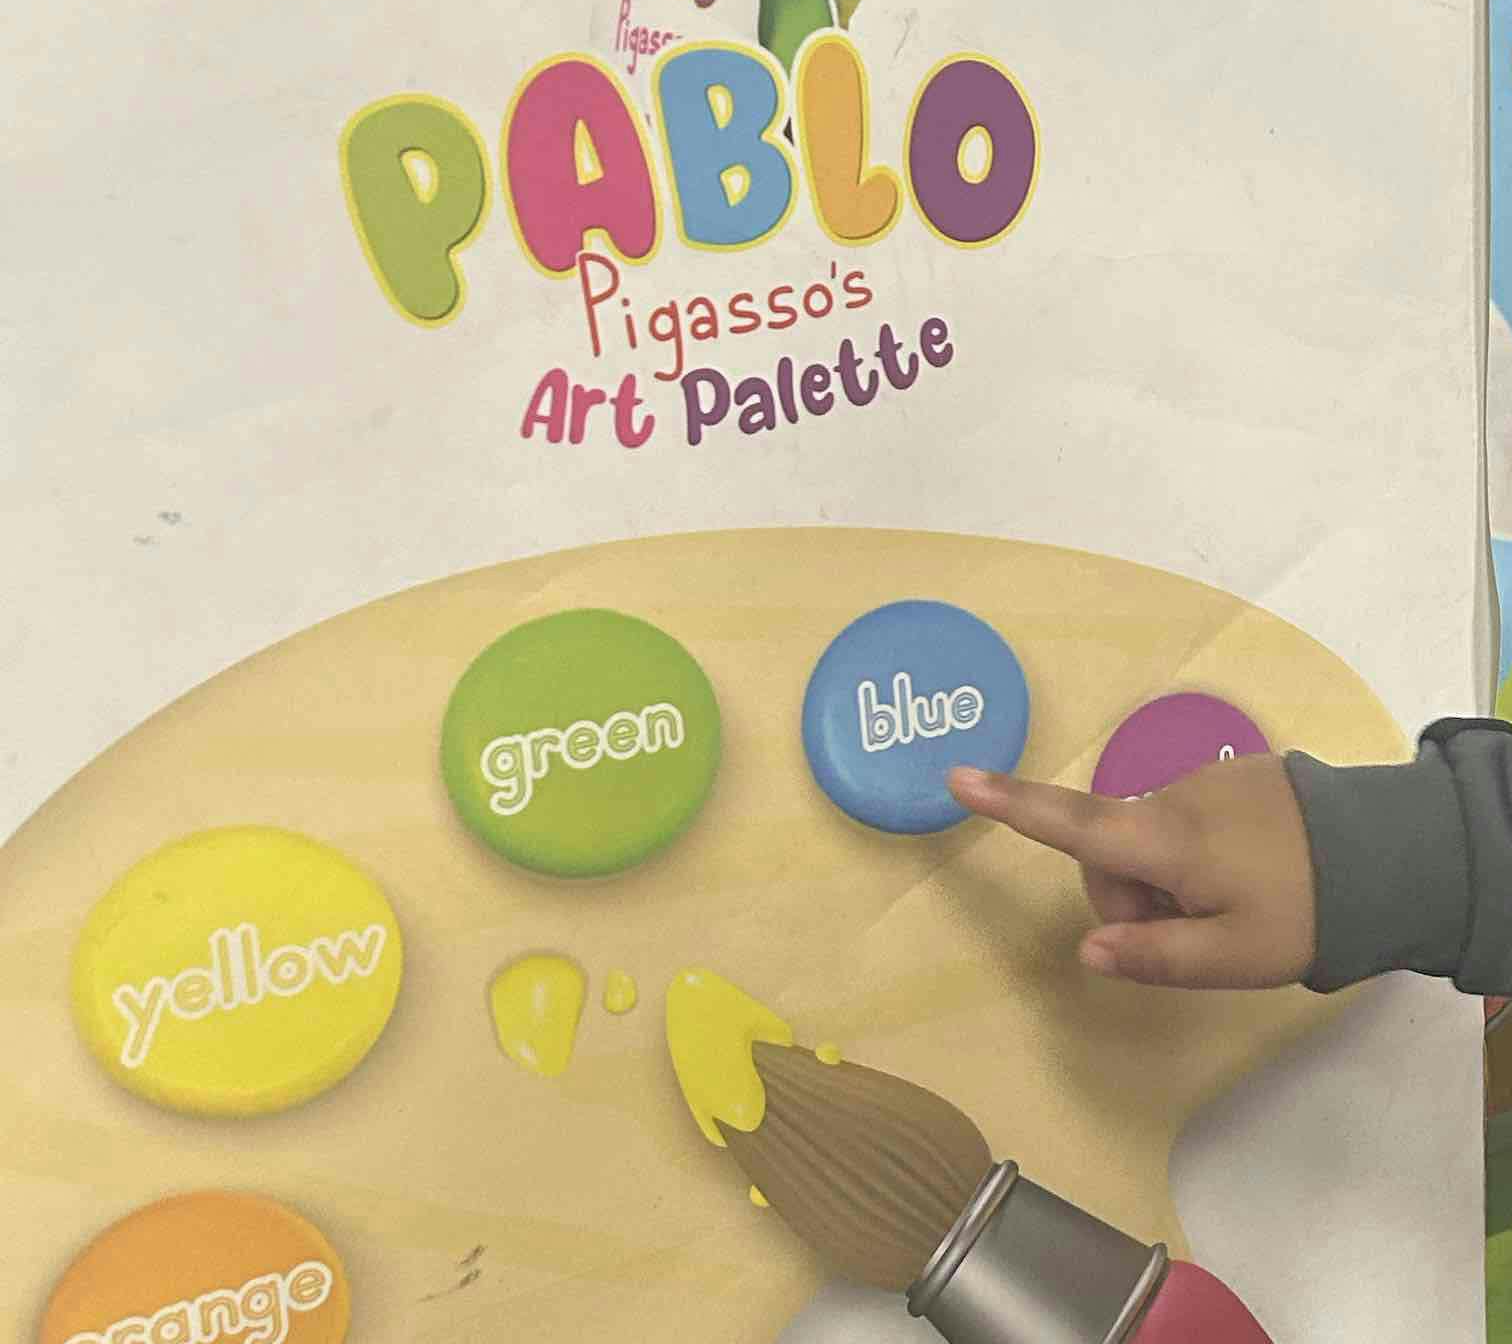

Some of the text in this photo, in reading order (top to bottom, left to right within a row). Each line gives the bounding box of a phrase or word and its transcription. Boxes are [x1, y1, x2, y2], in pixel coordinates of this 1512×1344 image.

[339, 33, 1041, 329] PABLO
[520, 316, 955, 449] Art Palette
[576, 252, 874, 382] Pigasso's
[480, 701, 685, 816] green
[856, 670, 985, 753] blue
[111, 921, 387, 1069] yellow
